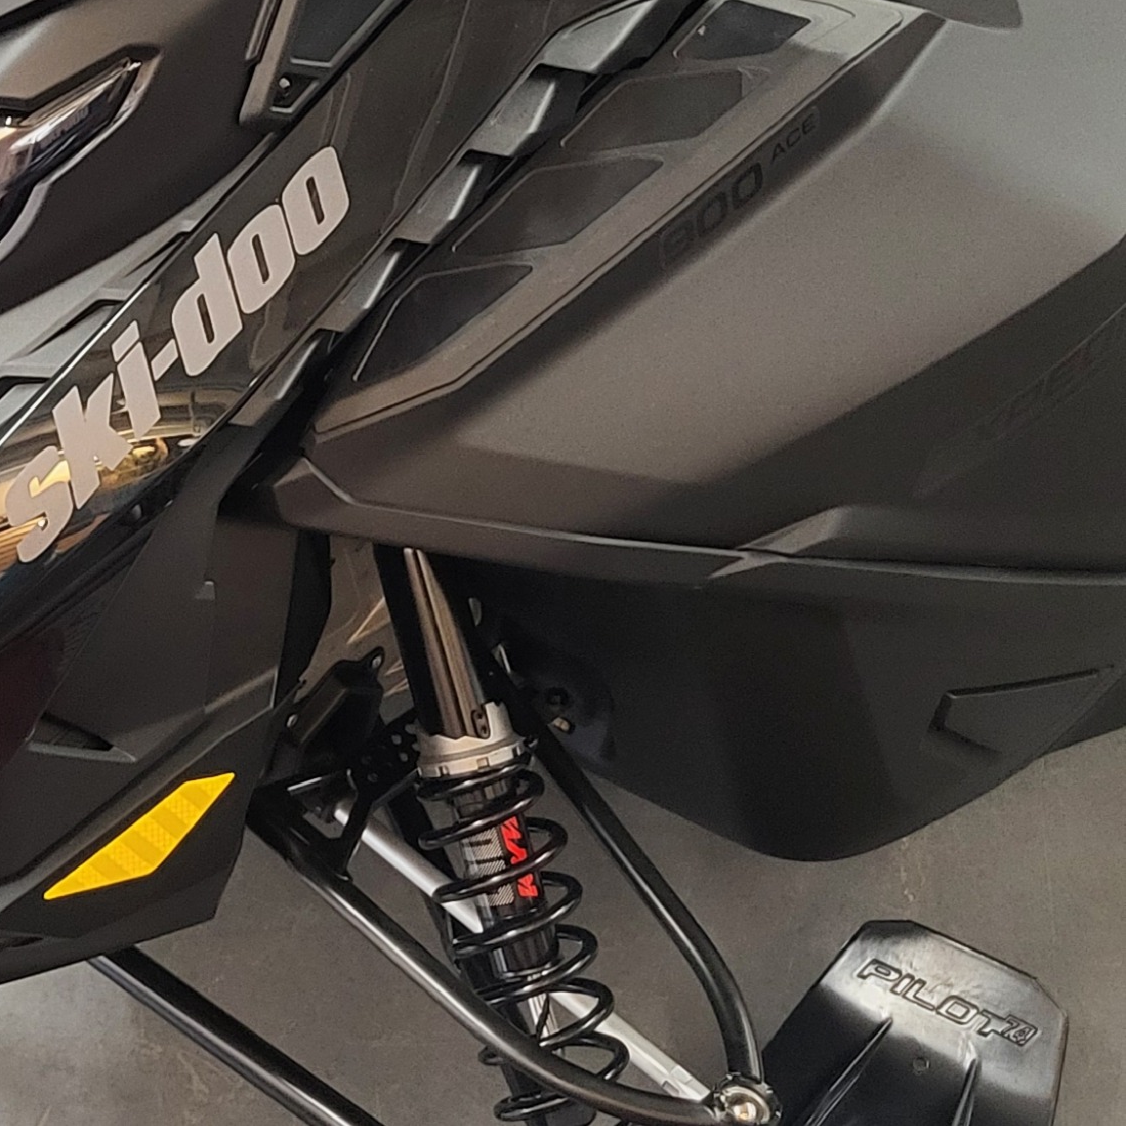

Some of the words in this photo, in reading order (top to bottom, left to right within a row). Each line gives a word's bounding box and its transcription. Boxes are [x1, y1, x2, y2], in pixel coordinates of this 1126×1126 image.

[772, 113, 816, 162] ACE
[5, 146, 349, 562] ski-doo
[856, 958, 1004, 1037] PILOT
